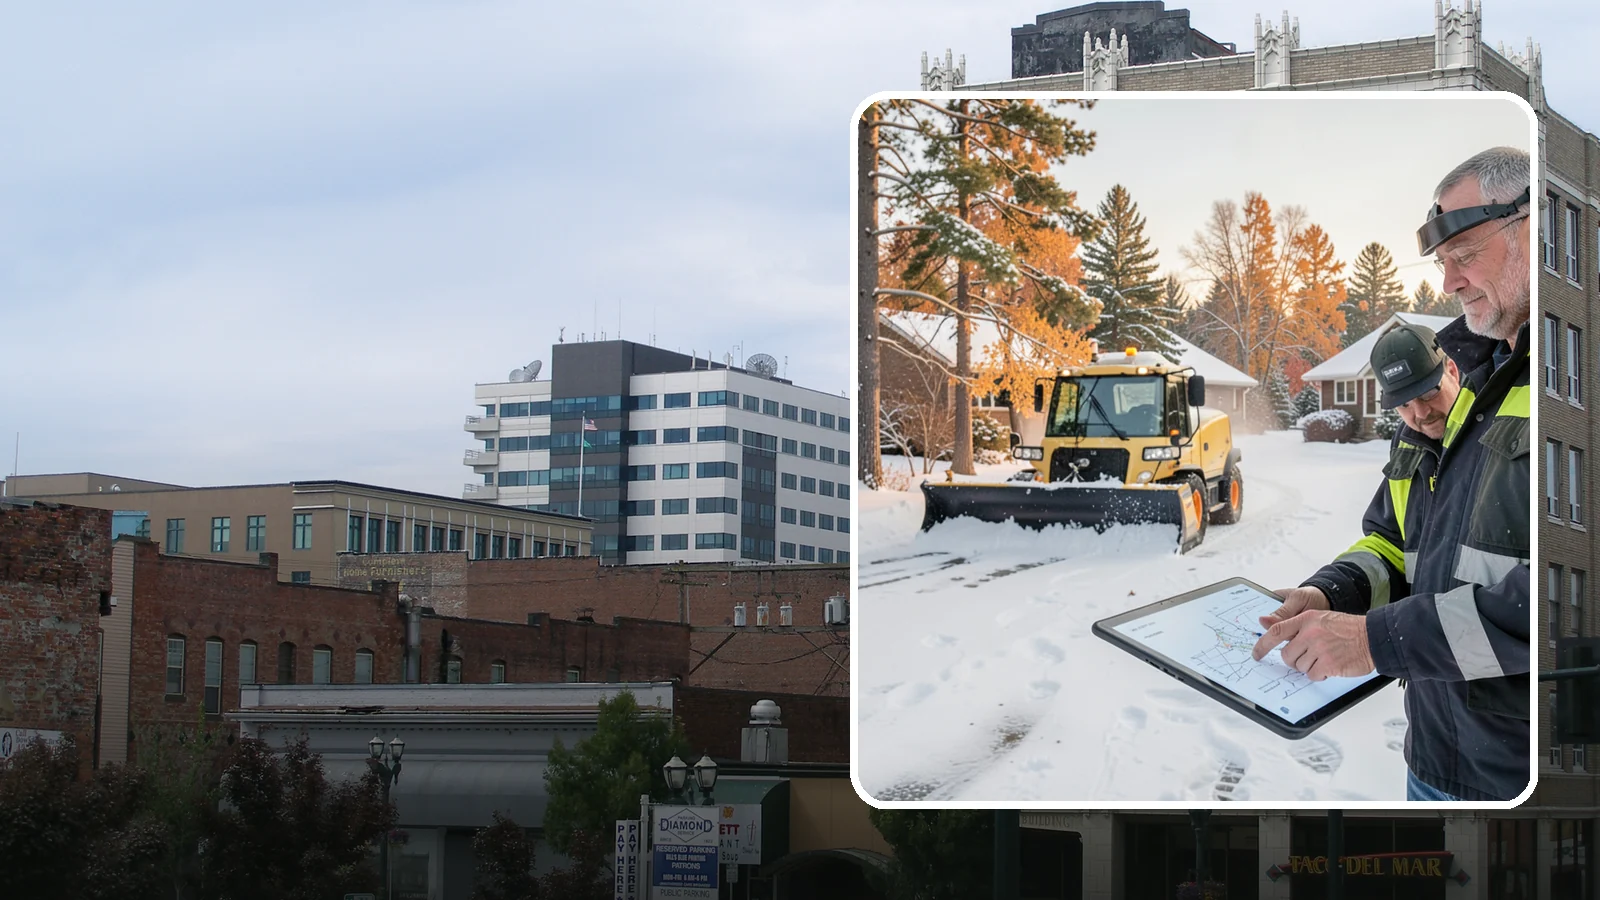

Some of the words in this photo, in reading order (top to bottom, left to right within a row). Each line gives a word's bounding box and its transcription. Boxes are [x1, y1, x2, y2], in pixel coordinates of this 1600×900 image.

[370, 566, 427, 577] Furnishers
[660, 818, 713, 833] DIAMOND
[1021, 815, 1070, 828] BUILDING
[617, 825, 625, 852] PAY
[628, 824, 637, 852] PAY
[656, 845, 688, 853] RESERVED
[689, 846, 716, 854] PARKING
[721, 851, 739, 862] Soup
[671, 862, 701, 870] PATRONS
[1289, 855, 1330, 875] TAC
[1345, 856, 1385, 876] DEL
[1391, 857, 1443, 877] MAR
[616, 856, 625, 894] HERE
[628, 855, 637, 893] HERE
[660, 889, 681, 897] PUBLIC
[684, 889, 710, 898] PARKING
